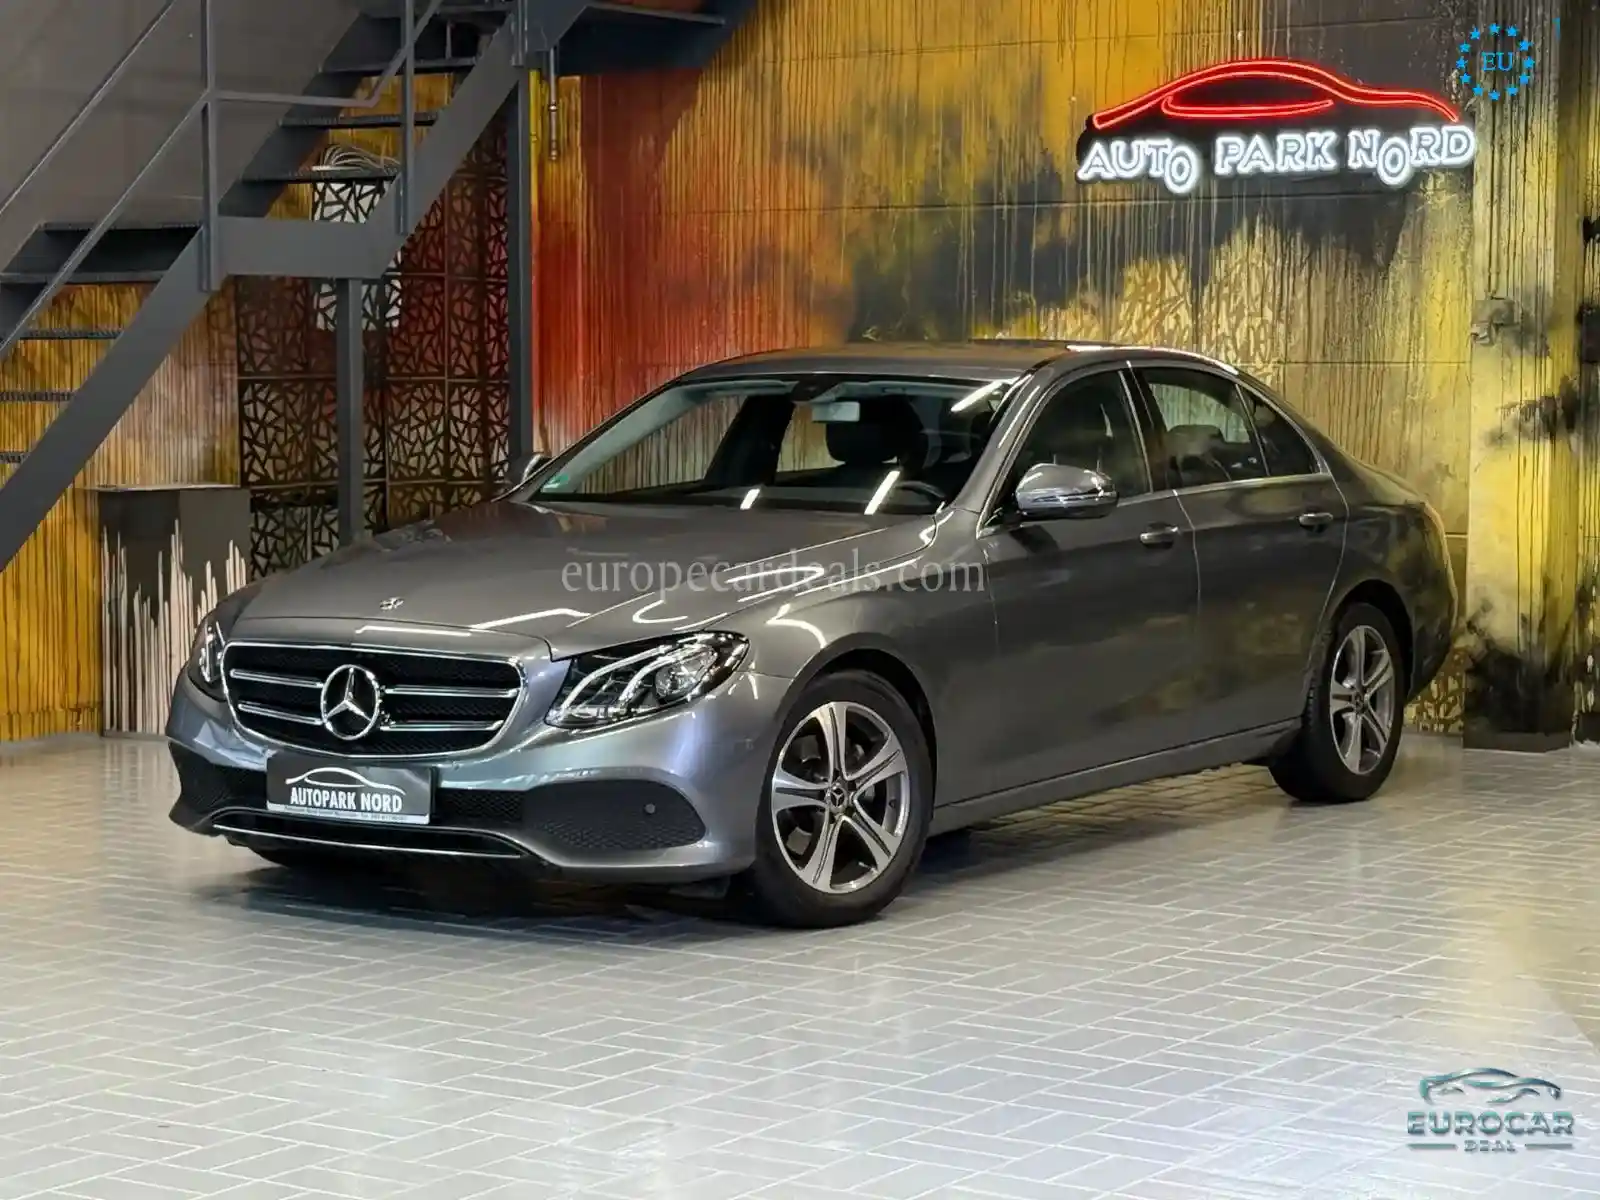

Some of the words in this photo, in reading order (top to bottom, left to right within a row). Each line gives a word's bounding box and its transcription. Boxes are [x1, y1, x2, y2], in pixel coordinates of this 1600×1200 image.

[1077, 137, 1199, 193] AUTO
[1214, 129, 1338, 176] PARK
[1347, 124, 1477, 186] NORD
[290, 787, 357, 810] AUTOPARK
[360, 792, 403, 813] NORD
